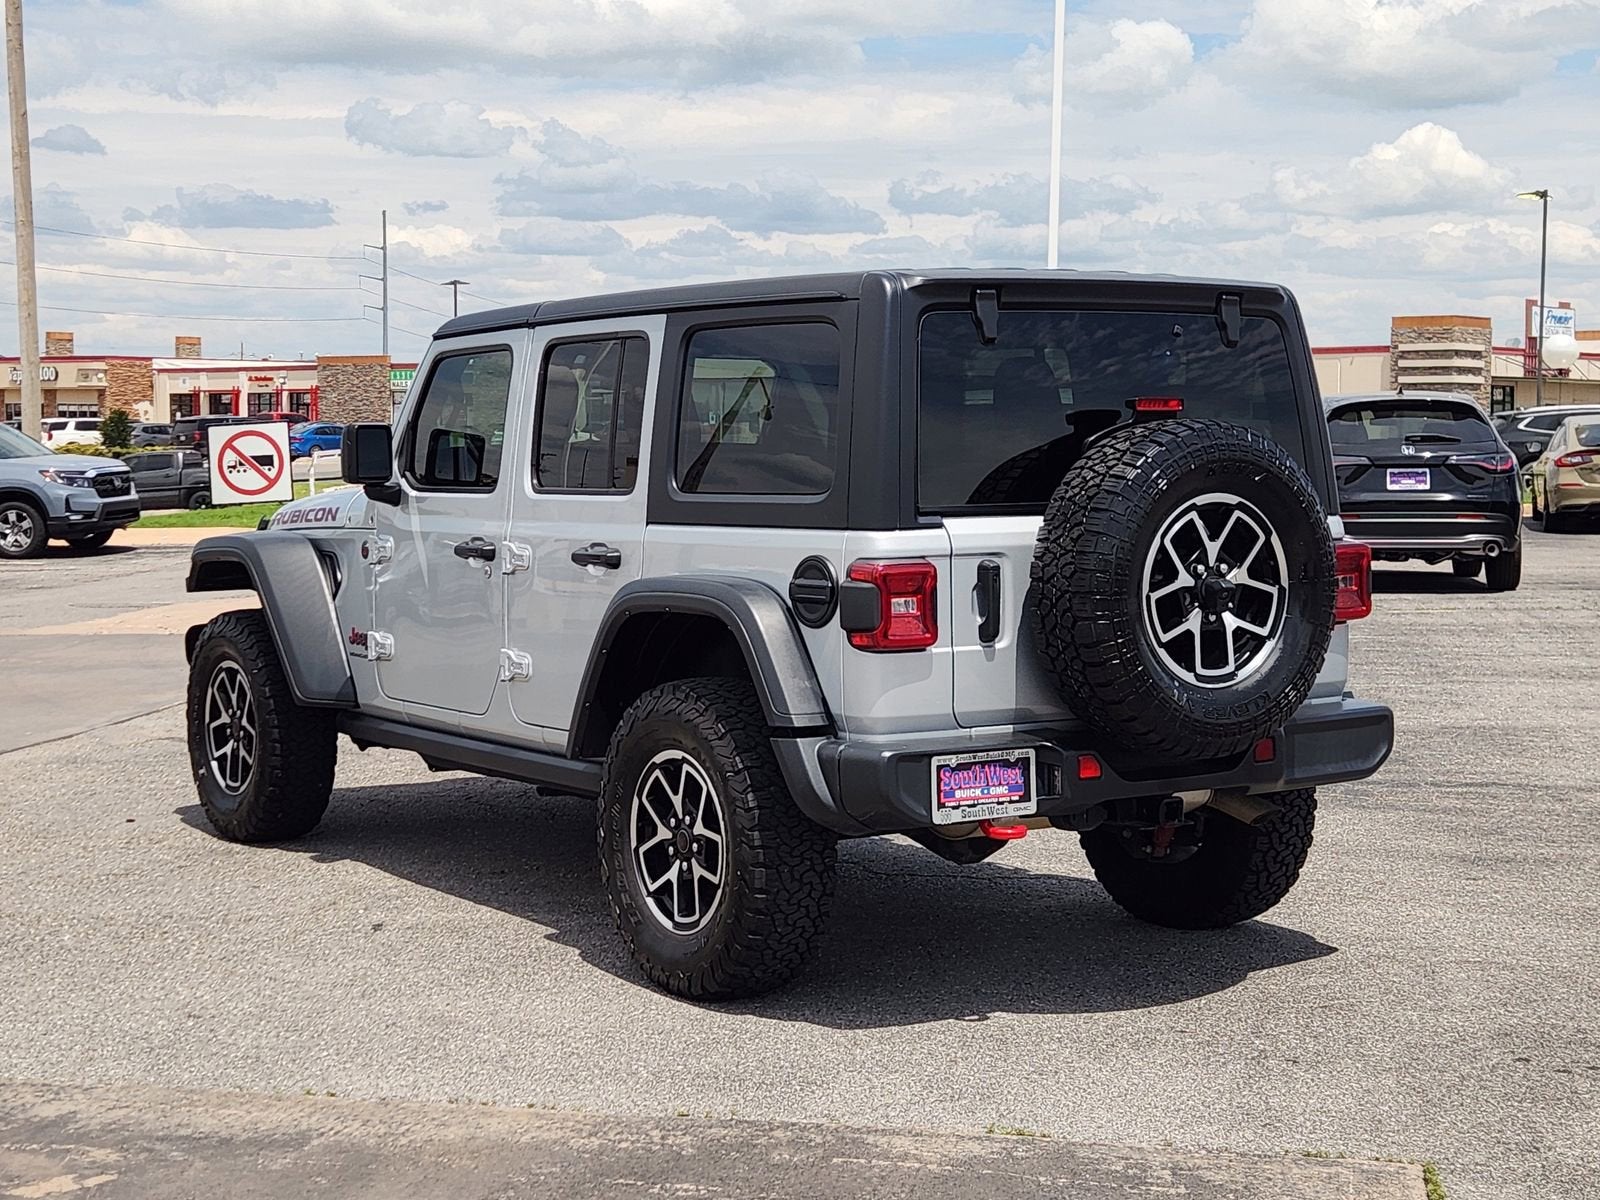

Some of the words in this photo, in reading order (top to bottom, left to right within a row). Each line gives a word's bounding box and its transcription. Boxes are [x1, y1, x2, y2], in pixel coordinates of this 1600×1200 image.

[271, 507, 340, 526] RUBICON
[941, 762, 1024, 790] SouthWest
[955, 787, 982, 798] BUICK
[990, 786, 1009, 795] GMC
[961, 805, 1008, 819] SouthWest
